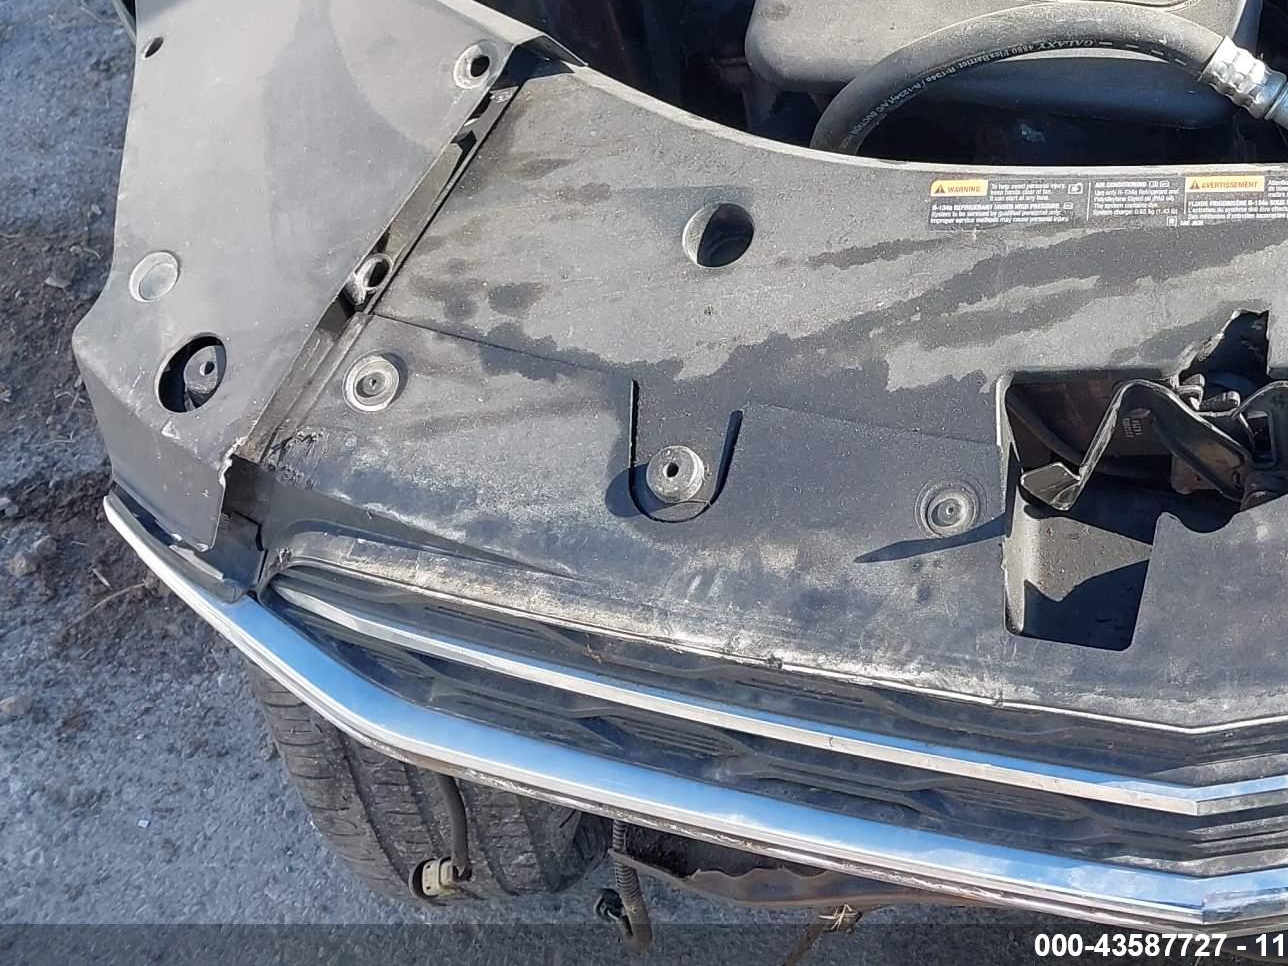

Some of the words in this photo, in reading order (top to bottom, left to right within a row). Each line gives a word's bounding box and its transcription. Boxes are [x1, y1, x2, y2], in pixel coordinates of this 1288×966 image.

[1037, 39, 1094, 49] GALAXY
[925, 66, 956, 82] R-134a
[947, 185, 981, 193] WARNING
[1201, 181, 1258, 189] AVERTISSEMENT
